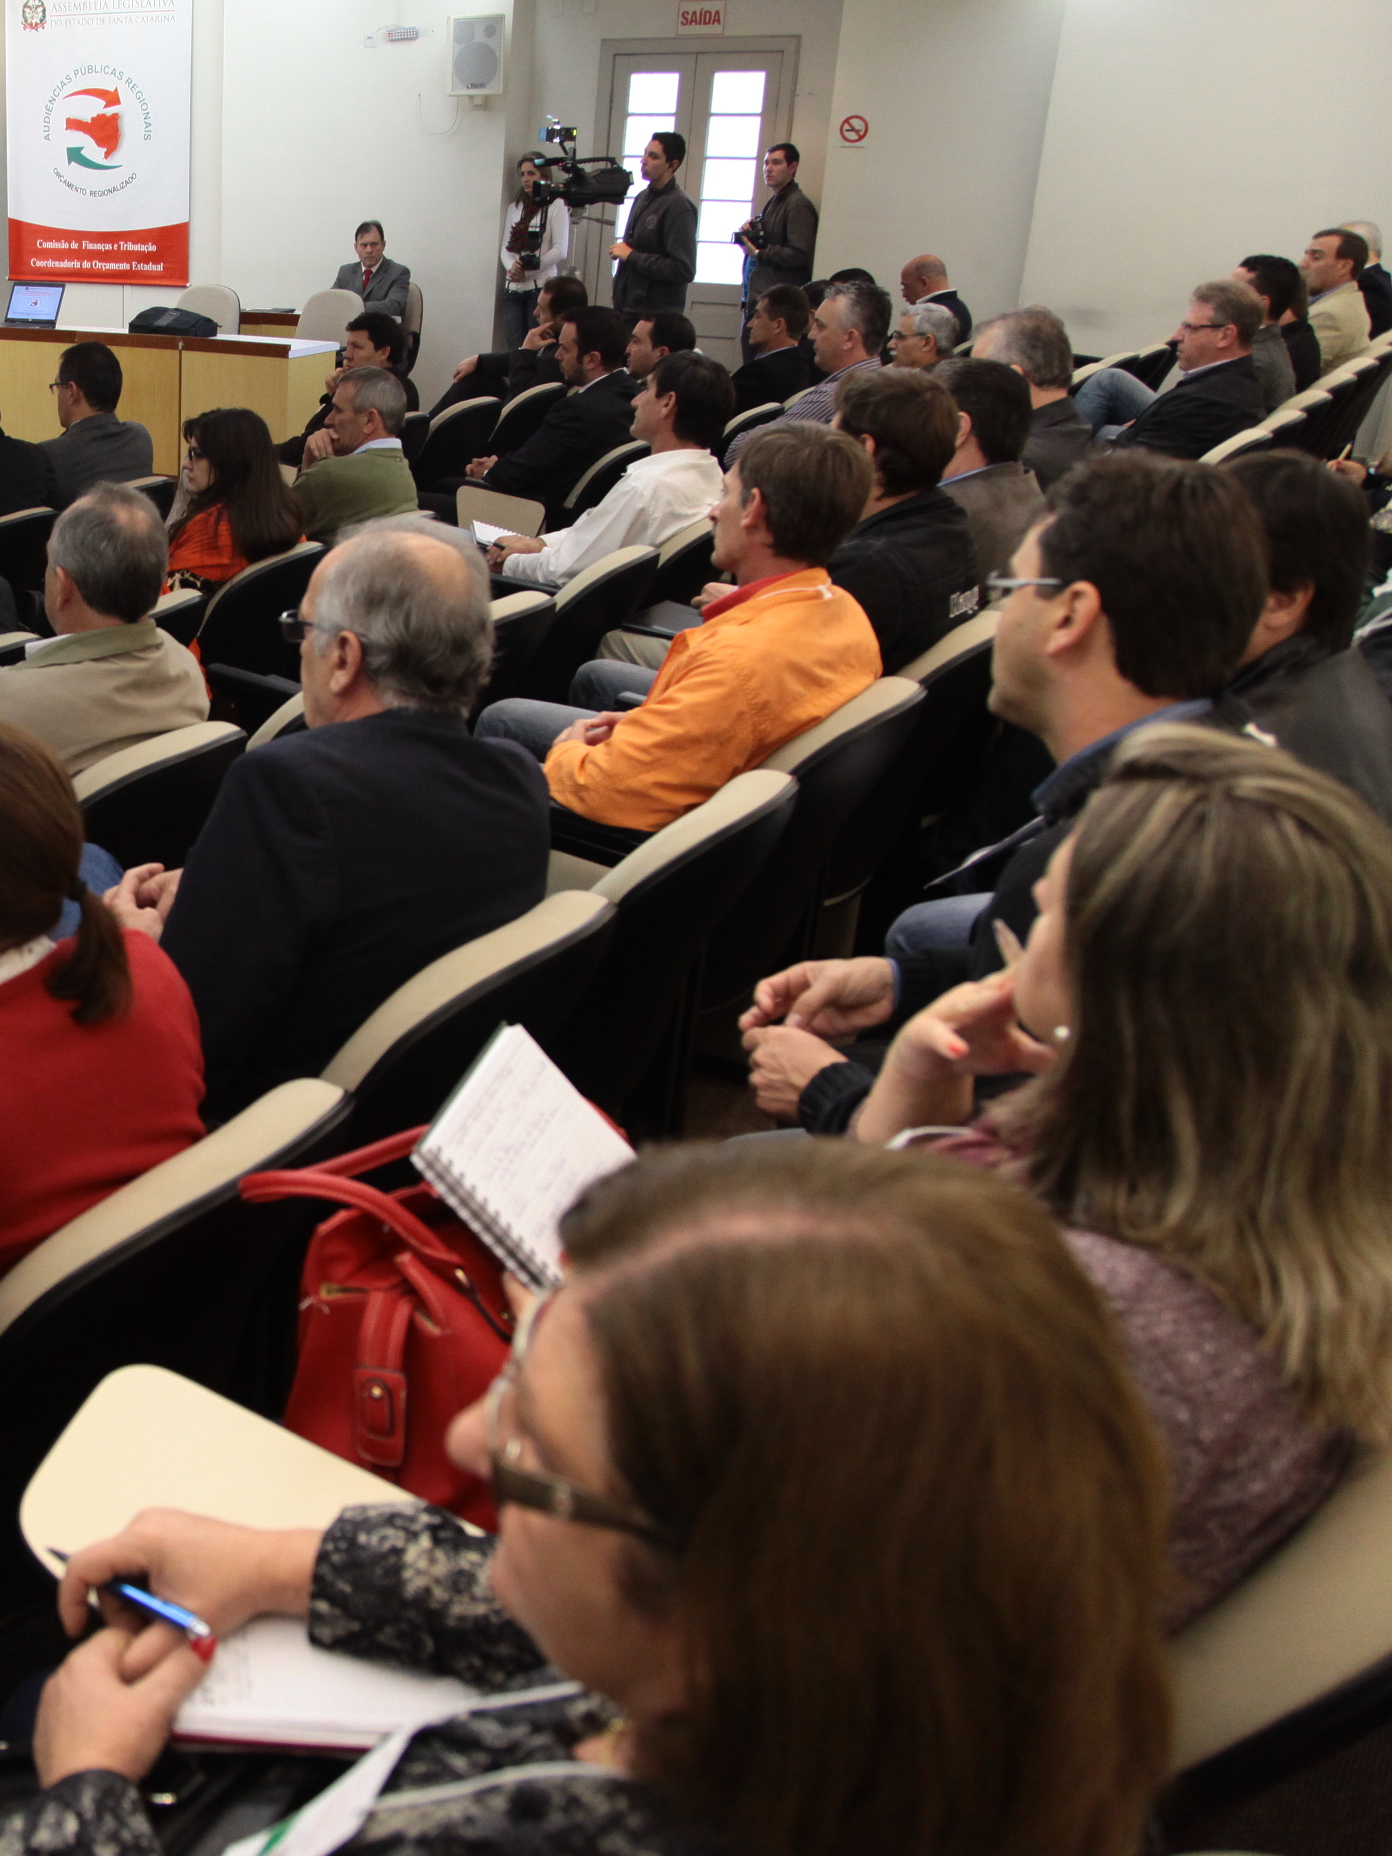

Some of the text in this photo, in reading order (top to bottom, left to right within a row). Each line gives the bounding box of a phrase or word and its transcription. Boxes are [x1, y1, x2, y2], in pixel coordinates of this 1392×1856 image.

[51, 0, 175, 12] ASSEMBLEIA LEGISLATIVA
[50, 14, 176, 27] DO ESTADO DE SANTA CATARINA
[680, 7, 721, 26] SAÍDA
[43, 64, 152, 141] AUDIÊNCIAS PÚBLICAS REGIONAIS
[52, 167, 137, 197] ORÇAMENTO REGIONALIZADO
[36, 239, 69, 249] Comissão
[70, 240, 79, 249] de
[82, 240, 112, 252] Finanças
[119, 241, 157, 253] Tributação
[30, 258, 164, 272] Coordenadoria do Orçamento Estadual
